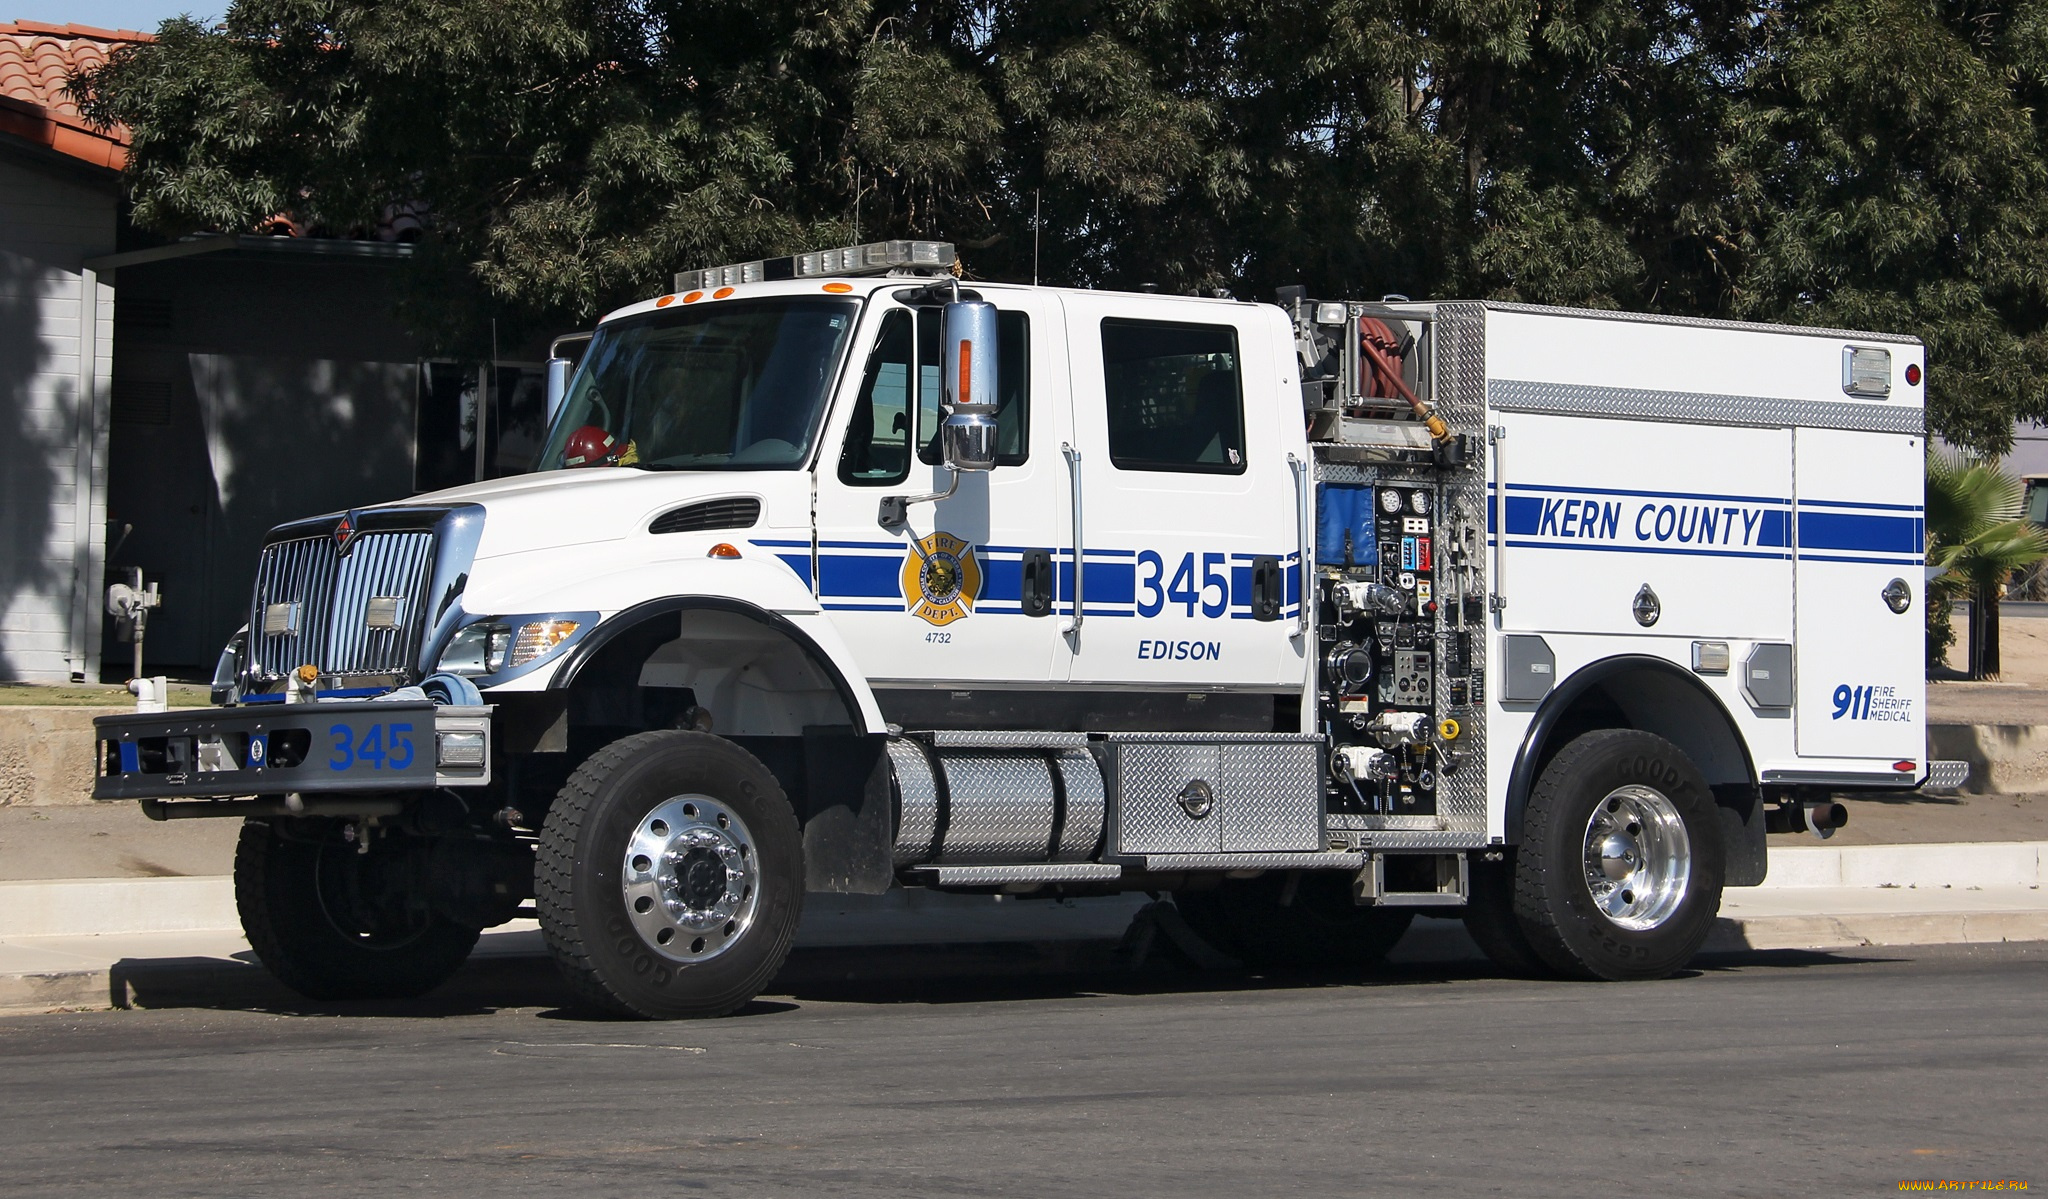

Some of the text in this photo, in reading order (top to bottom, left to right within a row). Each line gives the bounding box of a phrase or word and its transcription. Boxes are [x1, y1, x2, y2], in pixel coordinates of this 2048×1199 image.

[1541, 498, 1760, 545] KERN COUNTY
[926, 537, 957, 550] FIRE
[1137, 549, 1229, 619] 345
[923, 606, 958, 620] DEPT.
[925, 632, 951, 643] 4732
[1137, 640, 1221, 661] EDISON
[1873, 686, 1895, 697] FIRE
[1832, 684, 1873, 720] 911
[1871, 698, 1912, 709] SHERIFF
[1869, 710, 1911, 722] MEDICAL
[329, 723, 414, 771] 345
